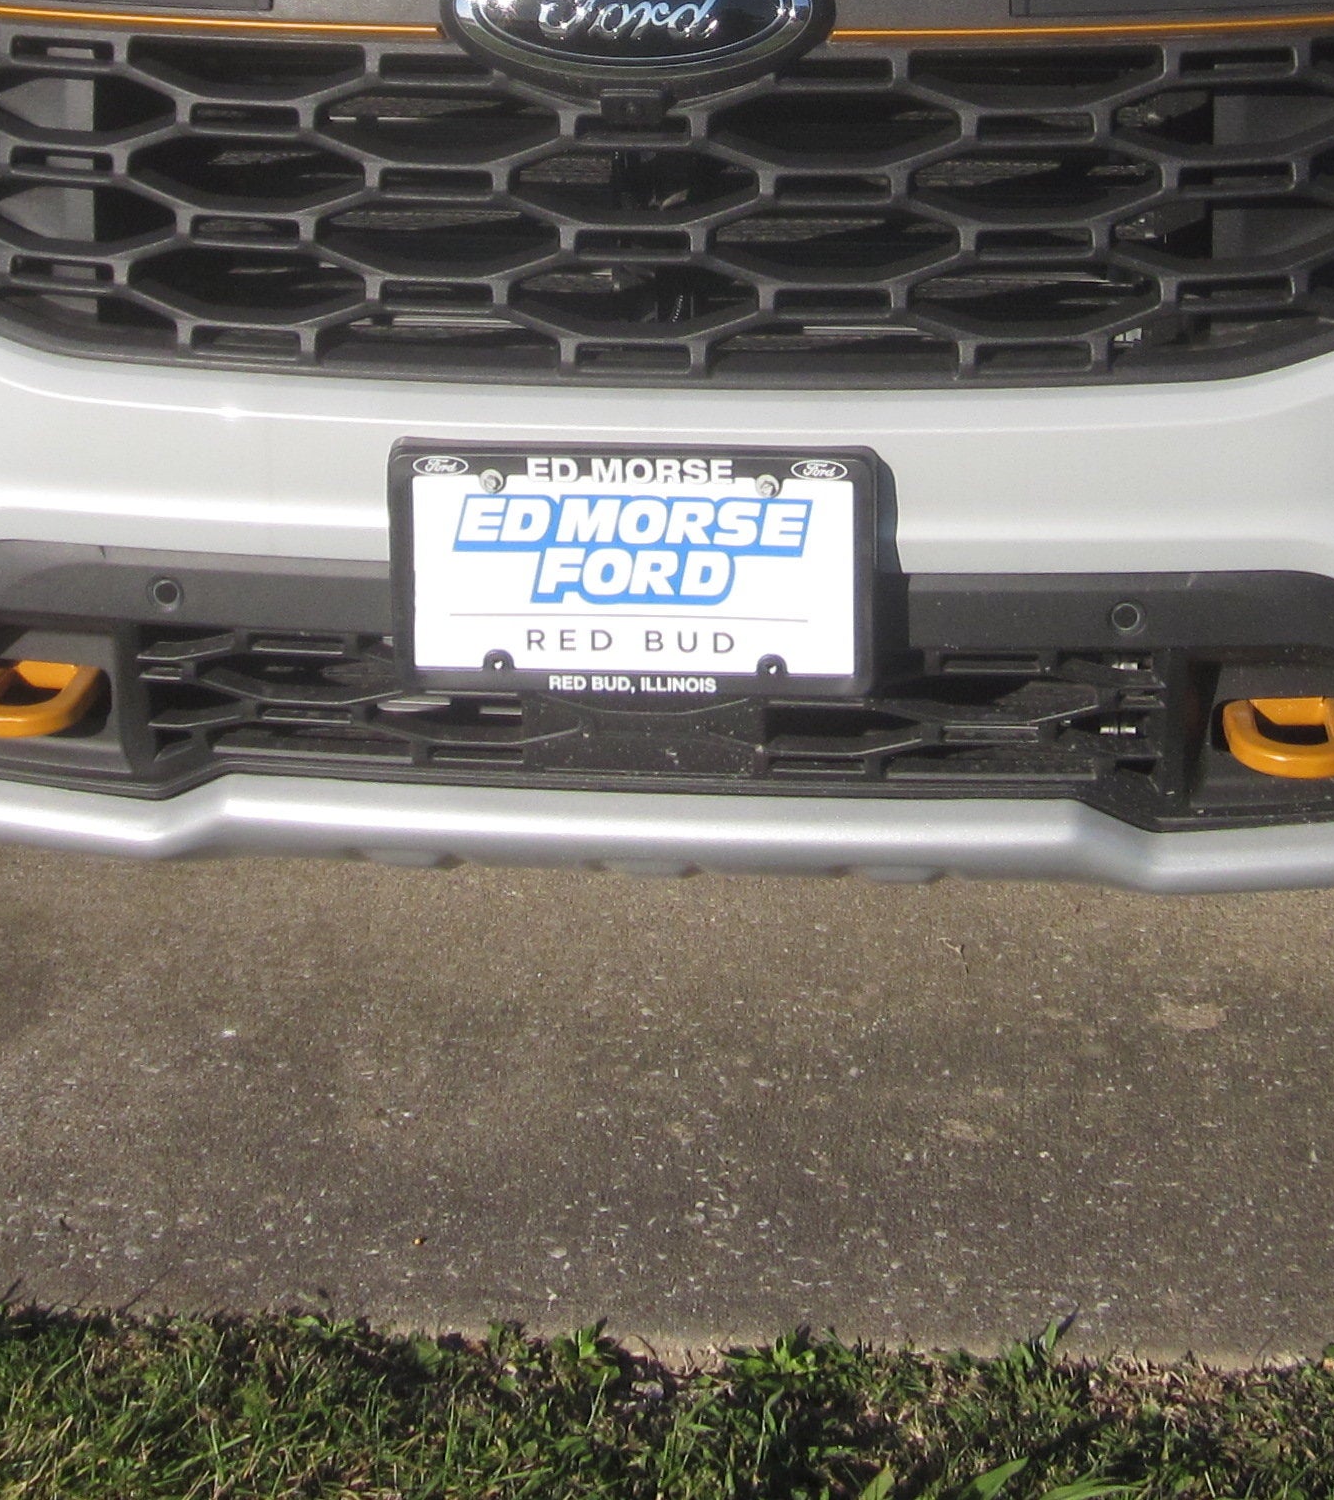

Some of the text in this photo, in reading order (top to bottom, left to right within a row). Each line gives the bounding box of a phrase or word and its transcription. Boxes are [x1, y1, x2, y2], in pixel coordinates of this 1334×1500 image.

[424, 459, 458, 472] Ford
[527, 457, 734, 486] ED MORSE
[802, 463, 837, 477] Ford
[456, 497, 809, 547] ED MORSE
[535, 546, 733, 598] FORD
[527, 628, 736, 654] RED BUD
[548, 674, 718, 695] RED BUD, ILLINOIS
